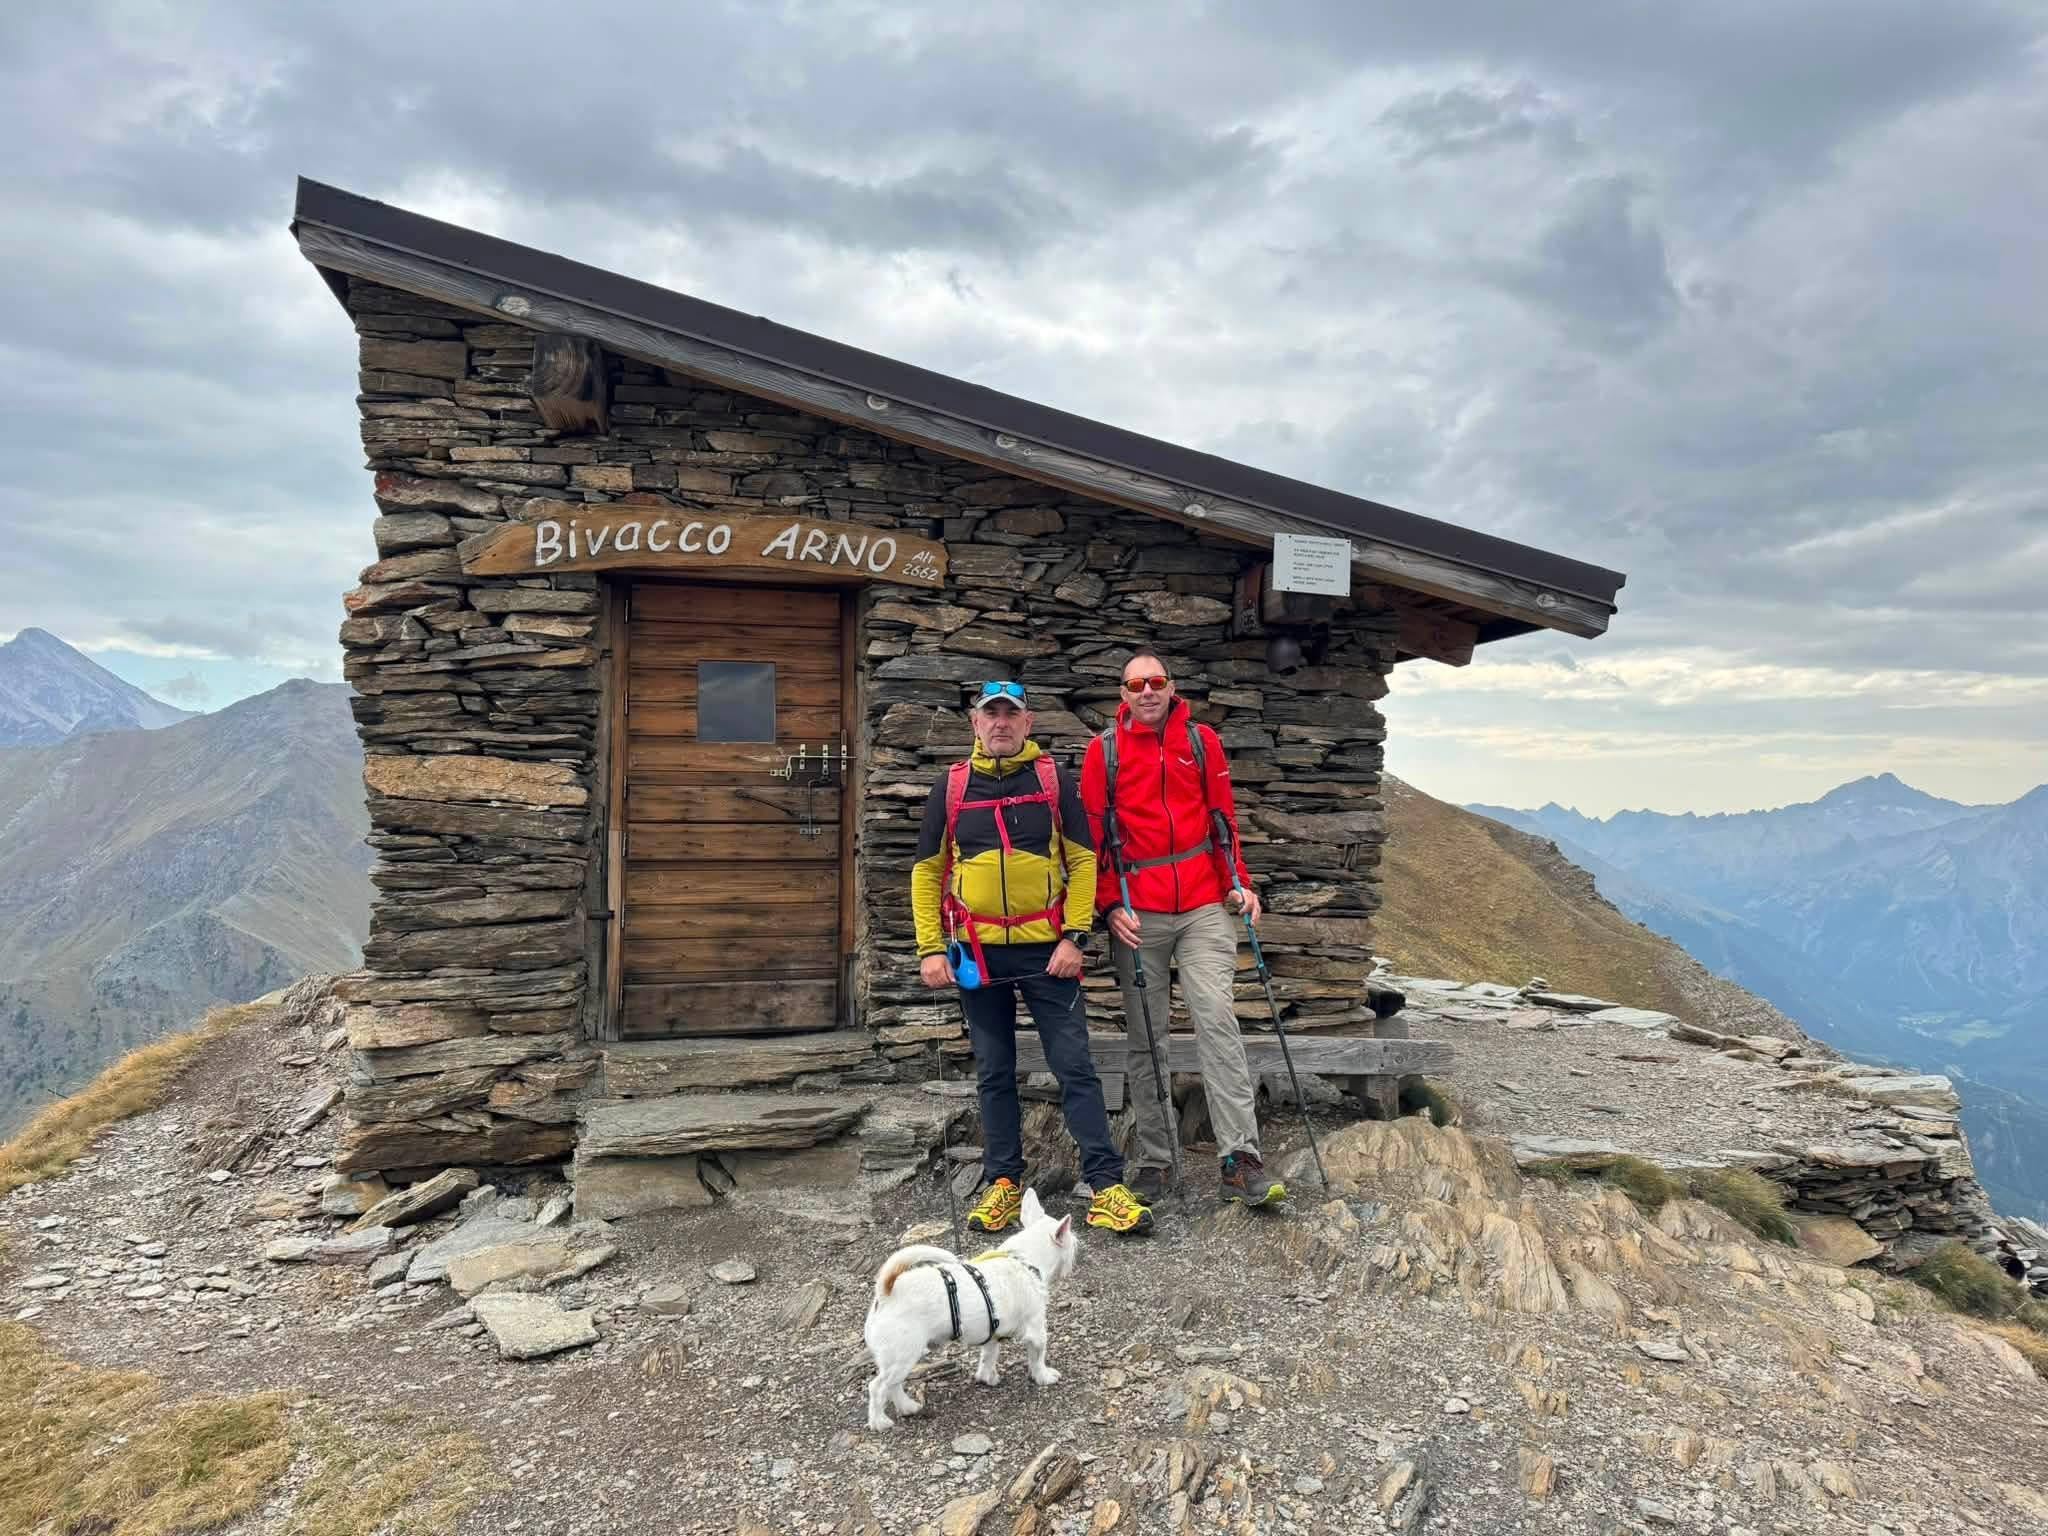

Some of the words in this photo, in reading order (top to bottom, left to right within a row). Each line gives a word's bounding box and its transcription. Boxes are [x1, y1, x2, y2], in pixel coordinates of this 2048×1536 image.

[535, 519, 732, 566] Bivacco
[761, 523, 897, 572] ARNO
[902, 563, 939, 580] 2662
